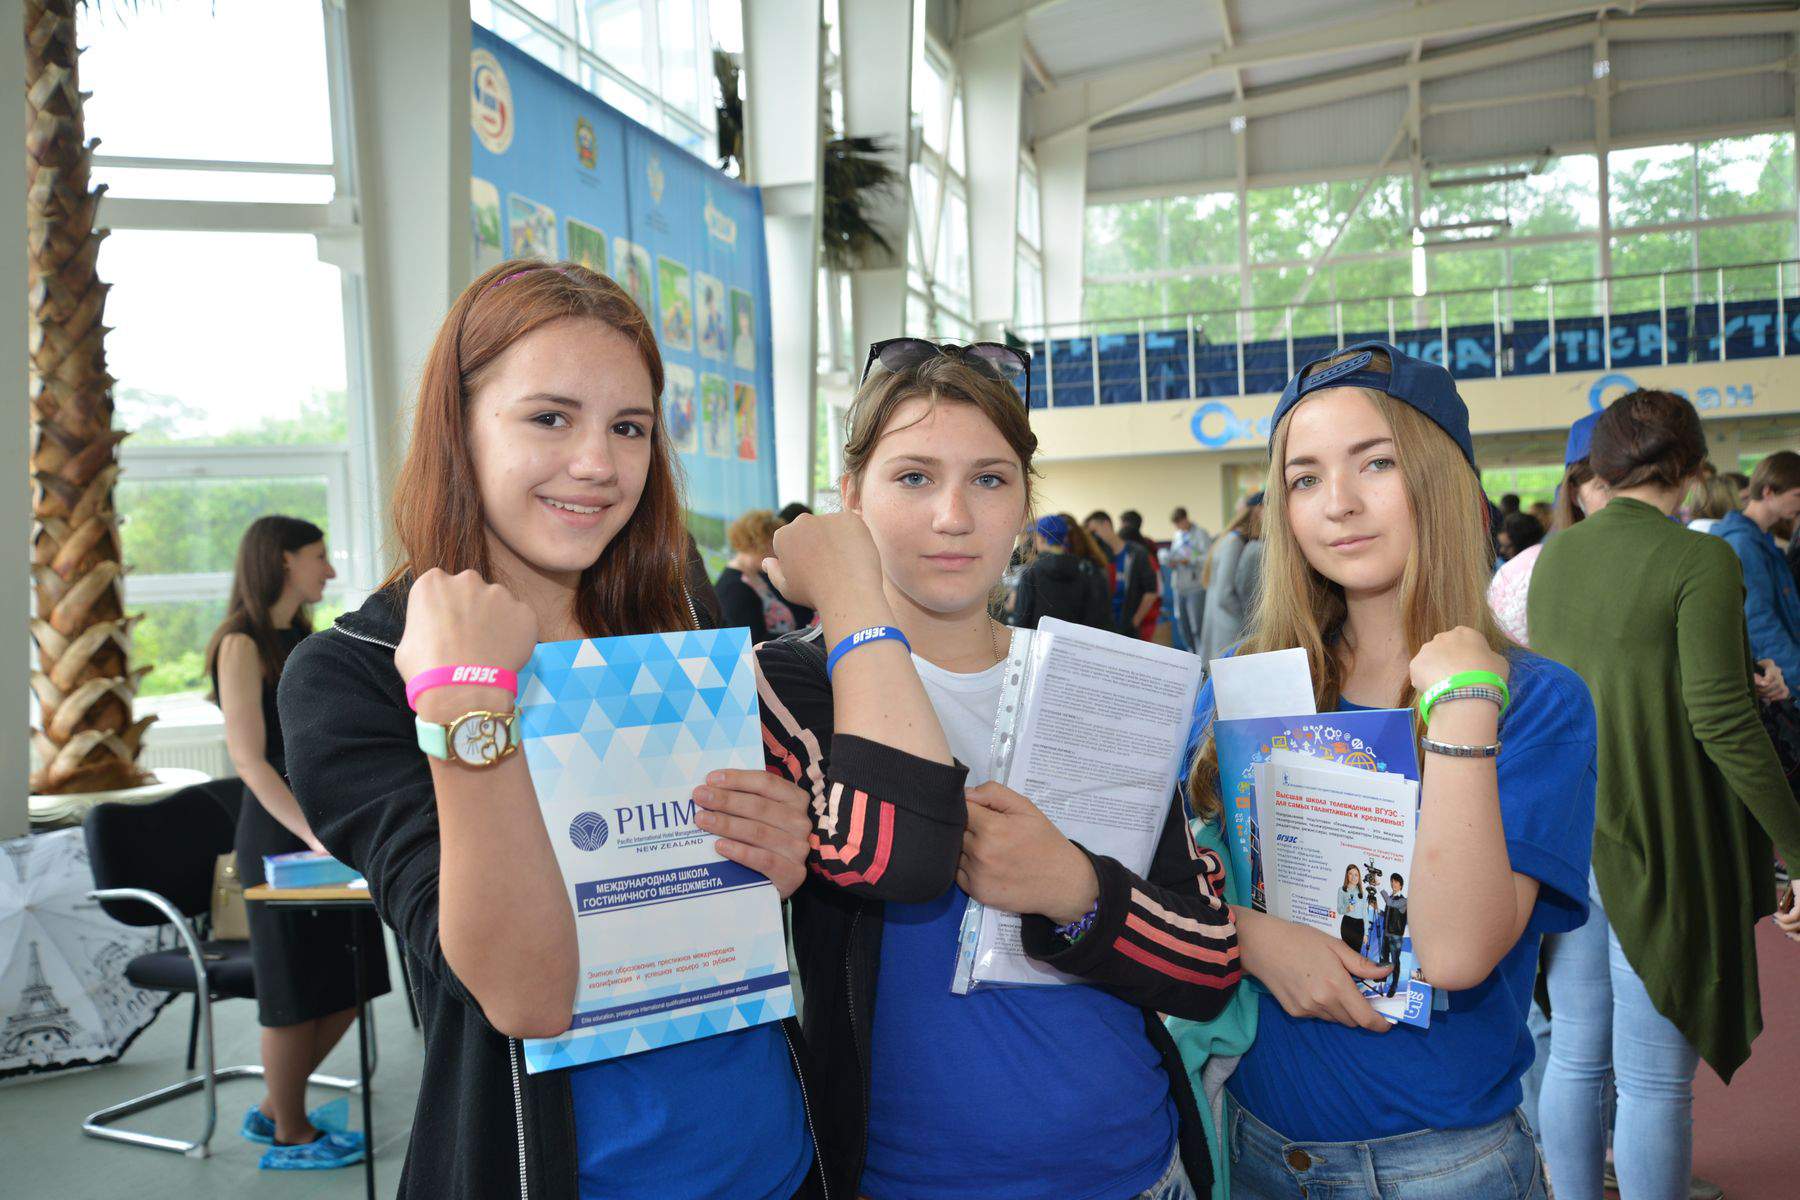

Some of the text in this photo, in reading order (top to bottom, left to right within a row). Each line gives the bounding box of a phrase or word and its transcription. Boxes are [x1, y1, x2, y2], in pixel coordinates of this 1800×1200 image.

[1525, 323, 1678, 365] STIGA
[853, 627, 886, 645] ВГУЭС
[452, 666, 499, 683] ВГУЭС
[1275, 790, 1303, 801] Высшая
[1306, 797, 1327, 805] школа
[1329, 800, 1372, 813] телевидения
[1375, 807, 1398, 818] ВГУЭС
[1287, 802, 1310, 811] самых
[1311, 806, 1353, 818] талантливых
[617, 837, 633, 845] Pacific
[633, 833, 662, 844] International
[636, 838, 704, 854] NEW ZEALAND
[1276, 834, 1298, 844] ВГУЭС
[596, 867, 709, 894] МЕЖДУНАРОДНАЯ ШКОЛА
[583, 877, 723, 909] ГОСТИНИЧНОГО МЕНЕДЖМЕНТА
